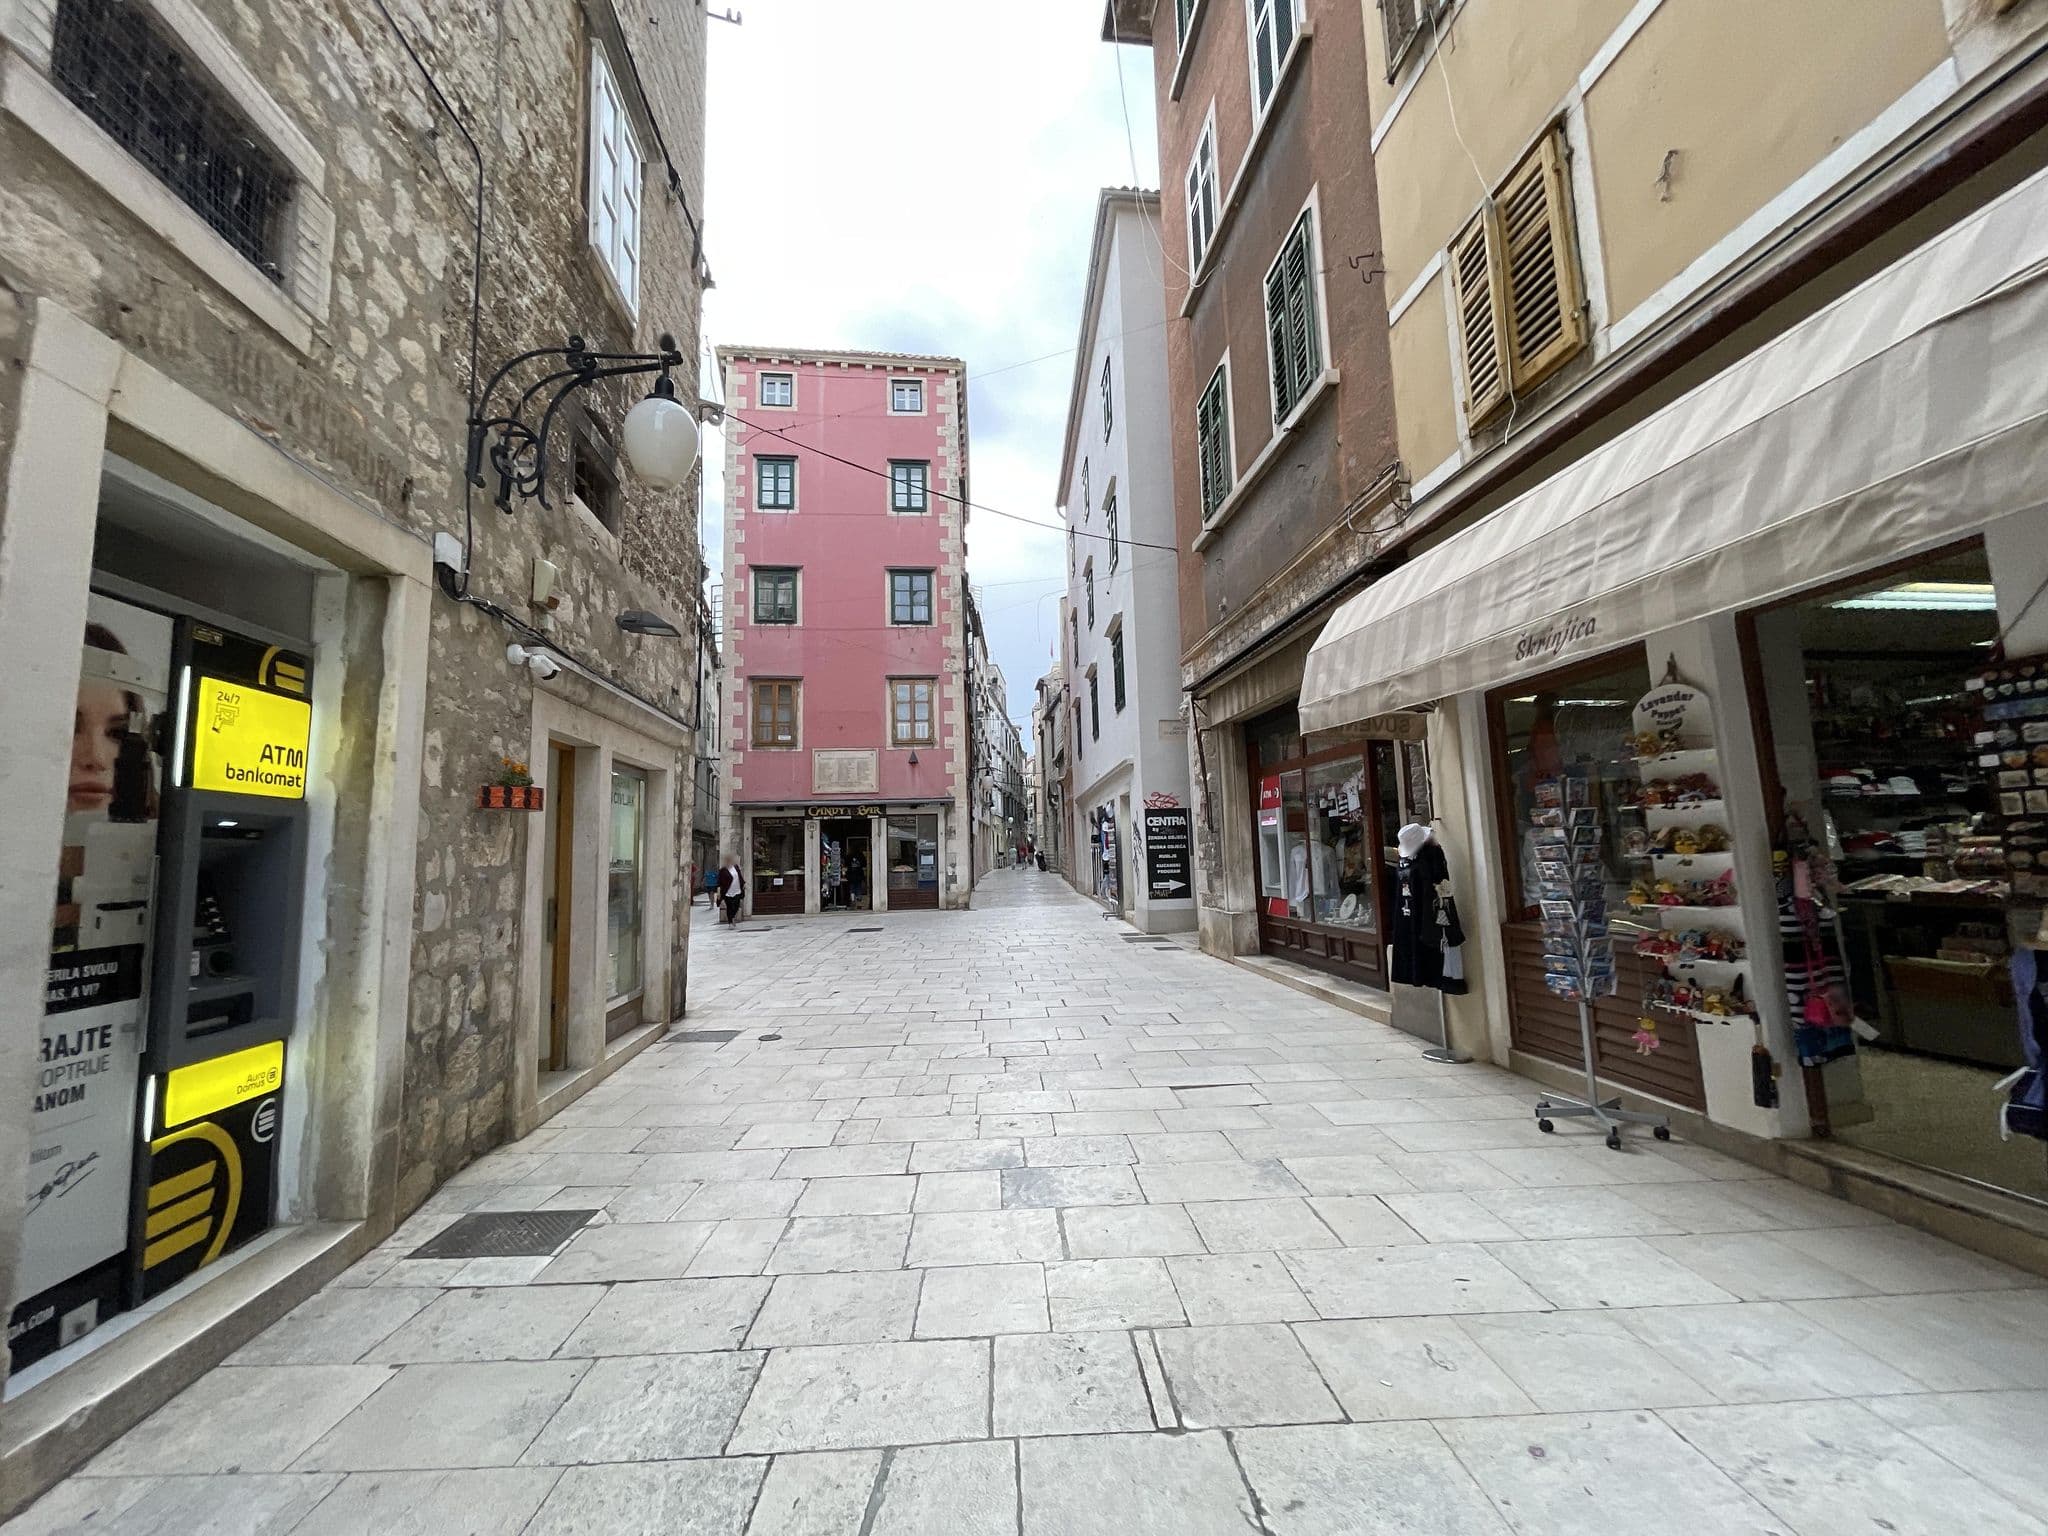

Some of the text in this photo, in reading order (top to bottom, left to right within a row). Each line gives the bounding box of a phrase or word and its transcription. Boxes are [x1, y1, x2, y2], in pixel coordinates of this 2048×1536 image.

[1515, 615, 1597, 662] Škrinjica
[217, 690, 241, 705] 24/7
[259, 743, 304, 769] ATM
[225, 761, 302, 788] bankomat
[857, 804, 882, 816] BAR
[1146, 816, 1186, 826] CENTRA
[236, 1079, 265, 1095] Domus
